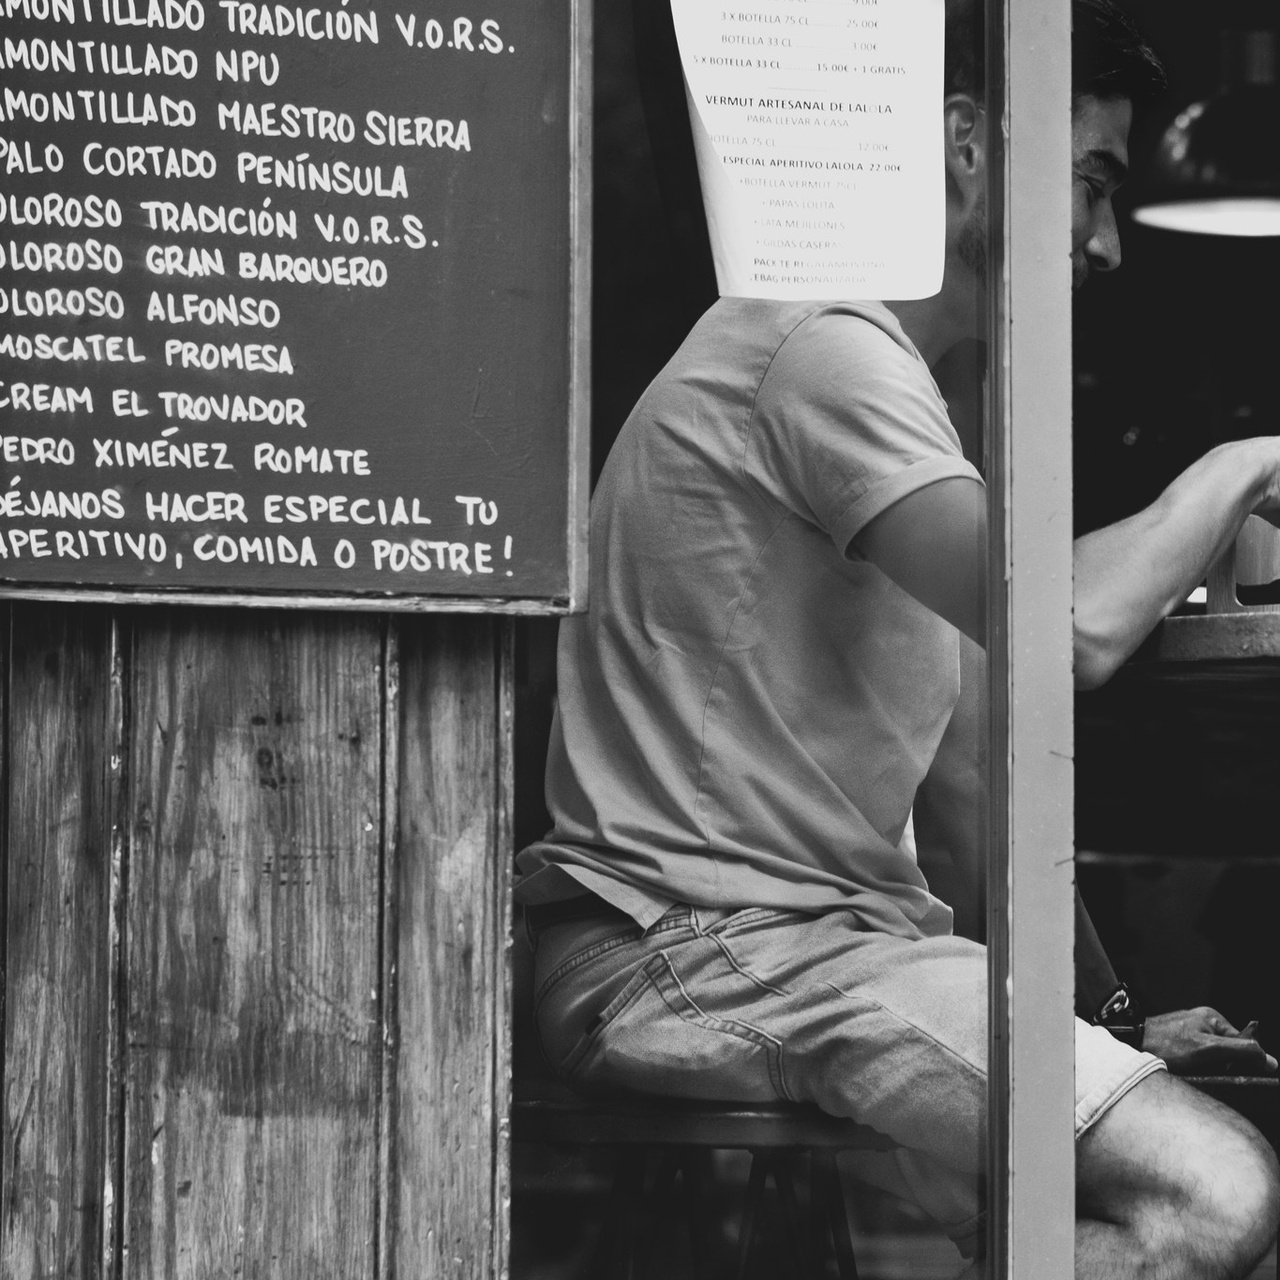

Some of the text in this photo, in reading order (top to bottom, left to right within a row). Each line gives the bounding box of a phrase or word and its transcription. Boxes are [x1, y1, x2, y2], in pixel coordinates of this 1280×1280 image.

[0, 37, 280, 87] MONTILLADO NPU
[0, 87, 472, 152] MONTILLADO MAESTRO SIERRA
[705, 94, 893, 115] VERMUT ARTESANAL DE LALOLA
[82, 142, 217, 179] CORTADO
[237, 151, 409, 199] PENÍNSULA
[723, 155, 902, 173] ESPECIAL APERITIVO LALOLA 2200€
[139, 196, 298, 240] TRADICIÓN
[145, 244, 226, 279] GRAN
[238, 251, 388, 288] BARQUERO
[146, 290, 281, 329] ALFONSO
[164, 338, 294, 376] PROMESA
[112, 388, 150, 418] EL
[157, 391, 308, 428] TROVADOR
[0, 426, 372, 476] EDRO XIMÉNEZ ROMATE
[145, 491, 249, 524] HACER
[263, 494, 432, 526] ESPECIAL
[454, 495, 499, 526] TU
[193, 533, 318, 567] COMIDA
[333, 538, 356, 569] O
